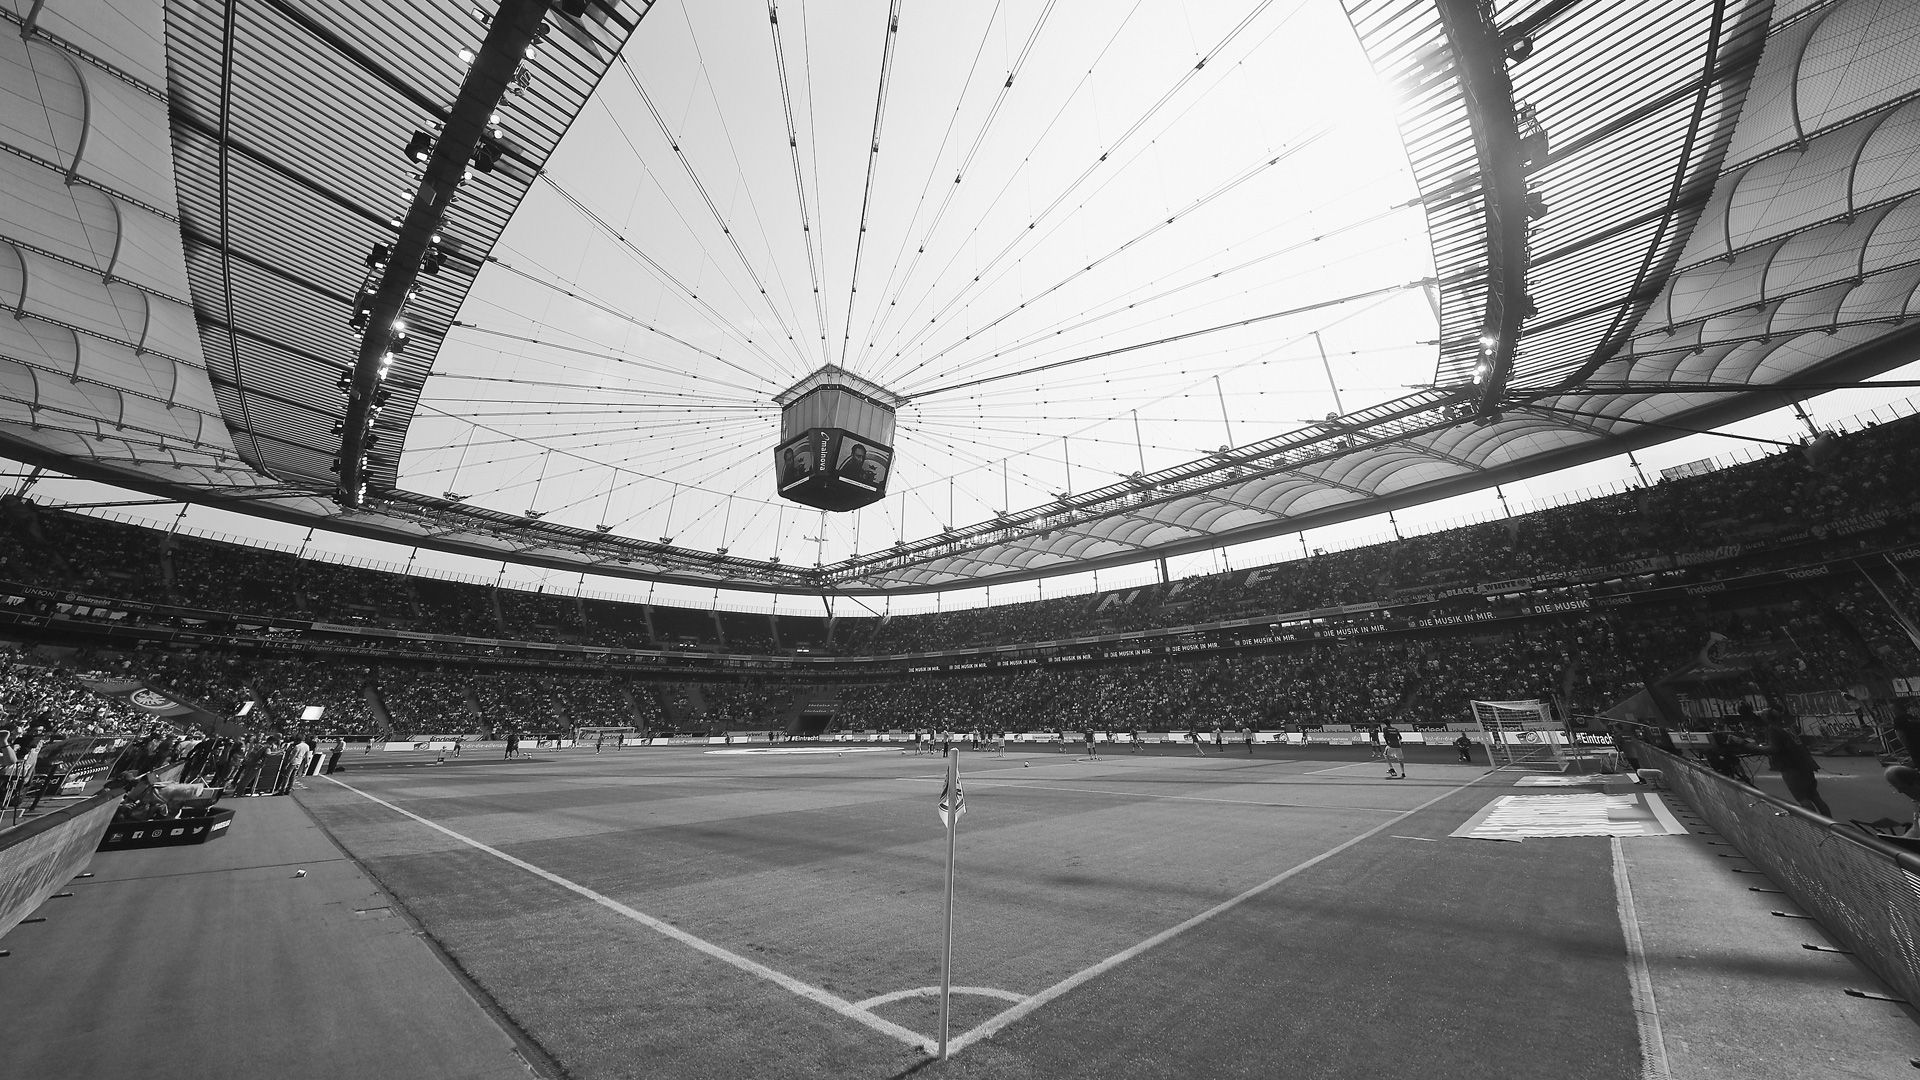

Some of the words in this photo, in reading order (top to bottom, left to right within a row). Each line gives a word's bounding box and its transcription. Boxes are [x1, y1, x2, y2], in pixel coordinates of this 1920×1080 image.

[1785, 565, 1829, 580] indeed
[1484, 580, 1517, 592] WHITE
[24, 588, 56, 598] UNION
[1534, 605, 1553, 614] DIE
[1554, 600, 1588, 611] MUSIK
[1419, 619, 1433, 627] DIE
[1434, 615, 1462, 625] MUSIK
[1464, 614, 1474, 622] IN
[1477, 611, 1497, 620] MIR.
[1336, 628, 1360, 636] MUSIK
[1371, 624, 1388, 632] MIR.
[1282, 634, 1297, 642] MIR.
[791, 734, 819, 742] #Eintracht
[1576, 732, 1614, 745] #Eintrach
